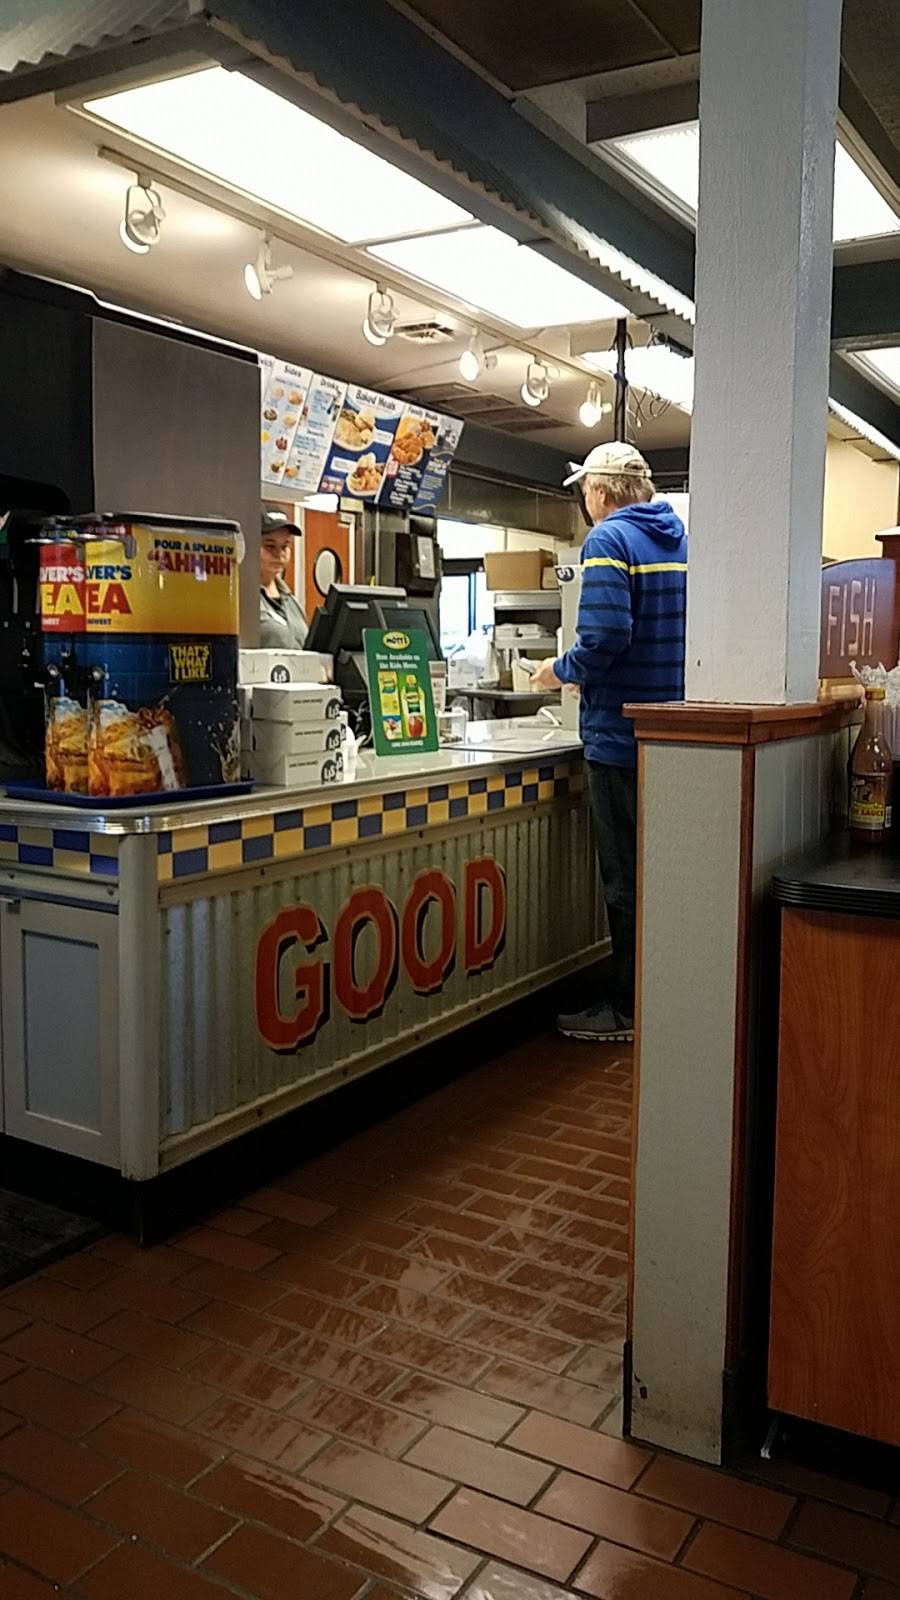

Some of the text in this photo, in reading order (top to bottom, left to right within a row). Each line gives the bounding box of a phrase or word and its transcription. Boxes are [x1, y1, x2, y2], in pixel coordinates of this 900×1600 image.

[154, 539, 181, 550] POUR
[184, 542, 190, 550] A
[192, 542, 224, 555] SPLASH
[826, 577, 876, 657] FISH
[171, 645, 210, 658] THAT'S
[173, 656, 208, 669] WHAT
[175, 668, 179, 680] I
[254, 854, 507, 1055] GOOD
